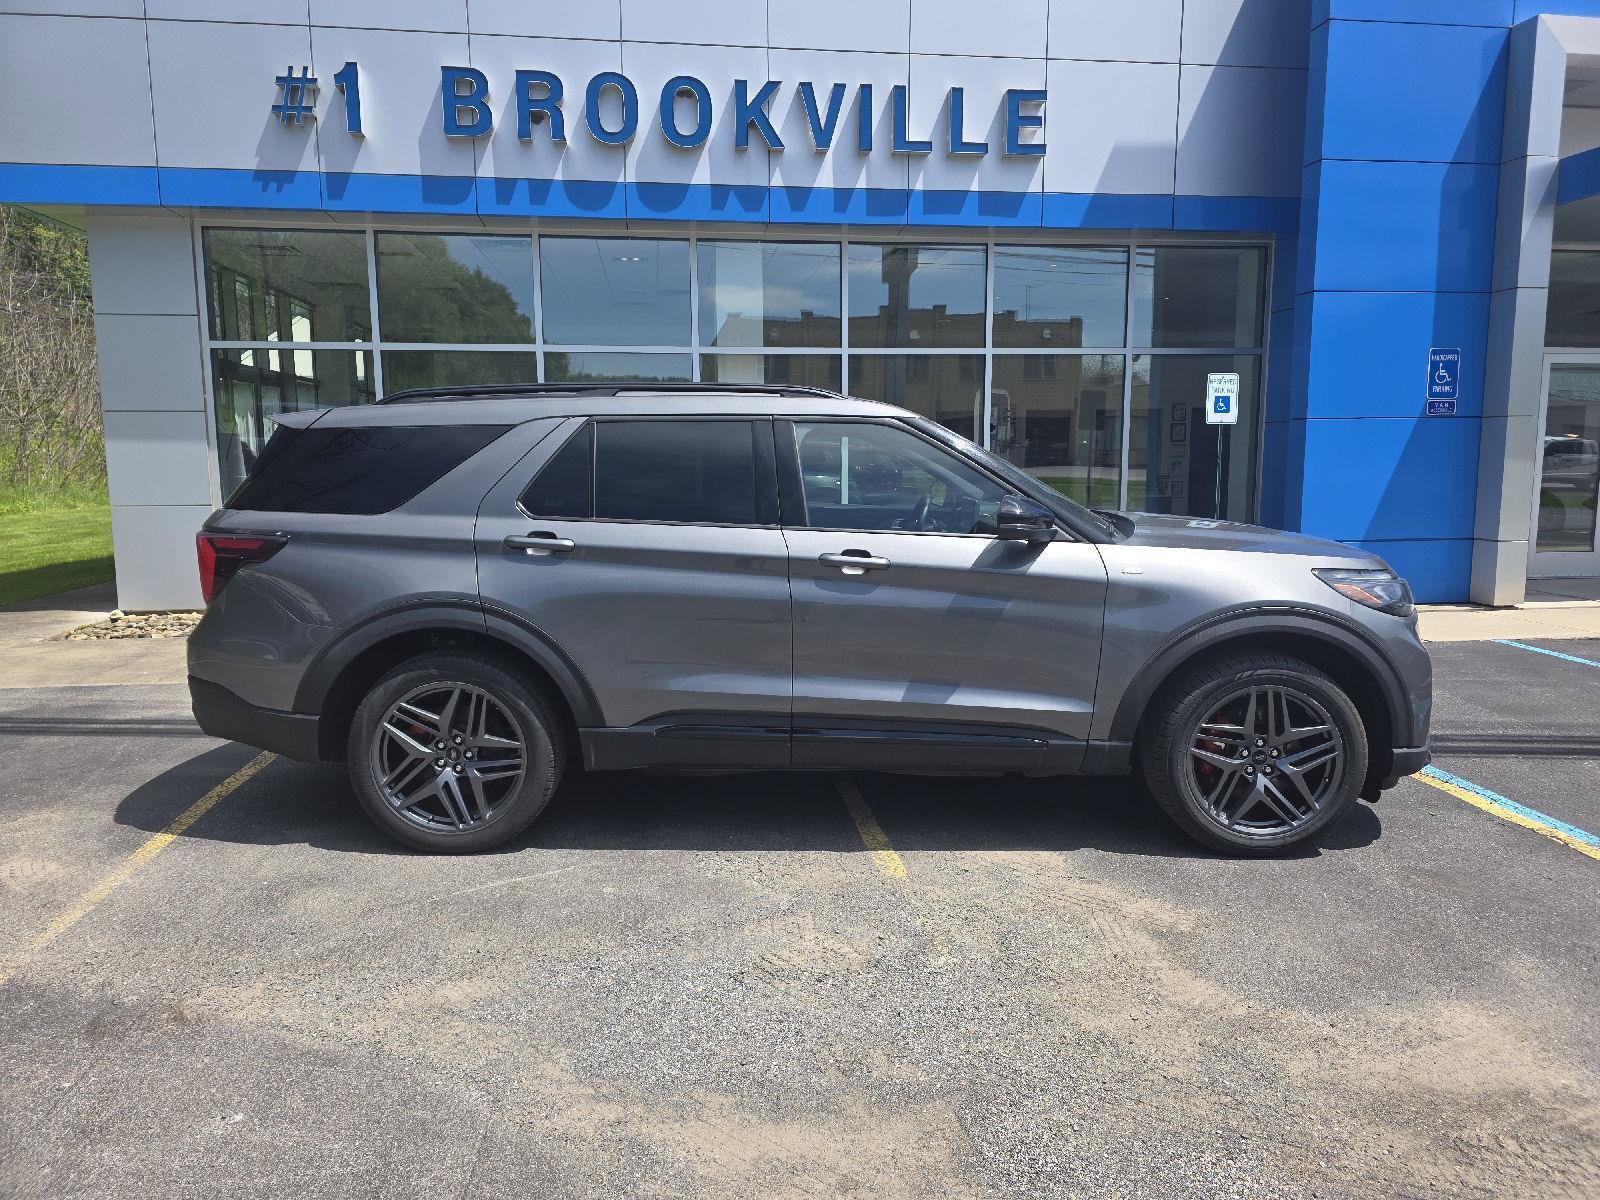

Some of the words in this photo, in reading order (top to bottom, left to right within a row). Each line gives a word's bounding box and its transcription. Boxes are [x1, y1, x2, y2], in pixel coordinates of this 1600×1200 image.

[271, 61, 362, 134] #1
[440, 65, 1048, 157] BROOKVILLE
[1432, 385, 1453, 393] PARKING
